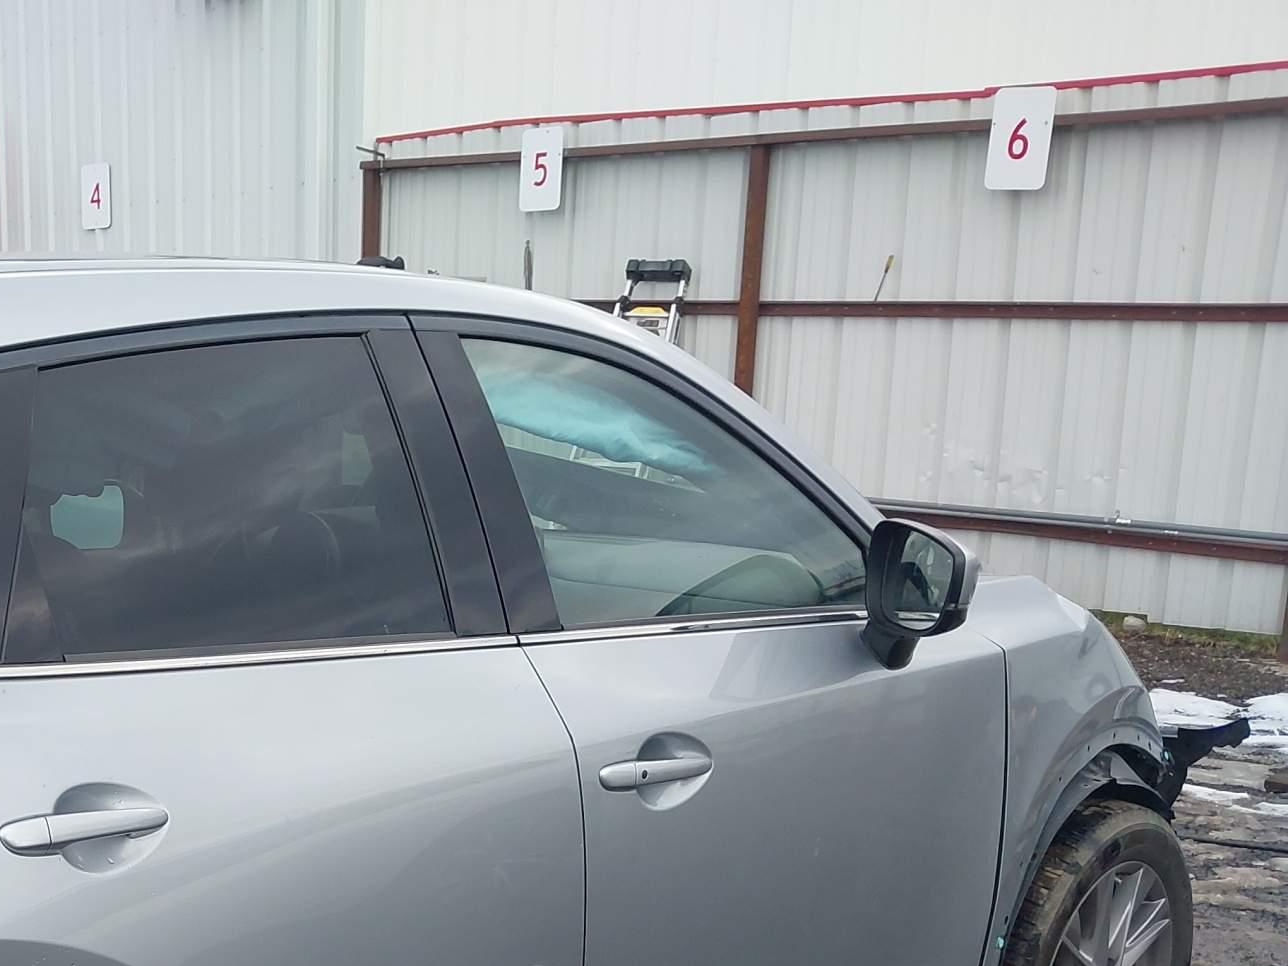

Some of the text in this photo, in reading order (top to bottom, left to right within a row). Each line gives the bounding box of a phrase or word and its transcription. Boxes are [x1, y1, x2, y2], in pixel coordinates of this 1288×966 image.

[1007, 117, 1029, 160] 6
[533, 151, 548, 187] 5
[90, 182, 101, 210] 4
